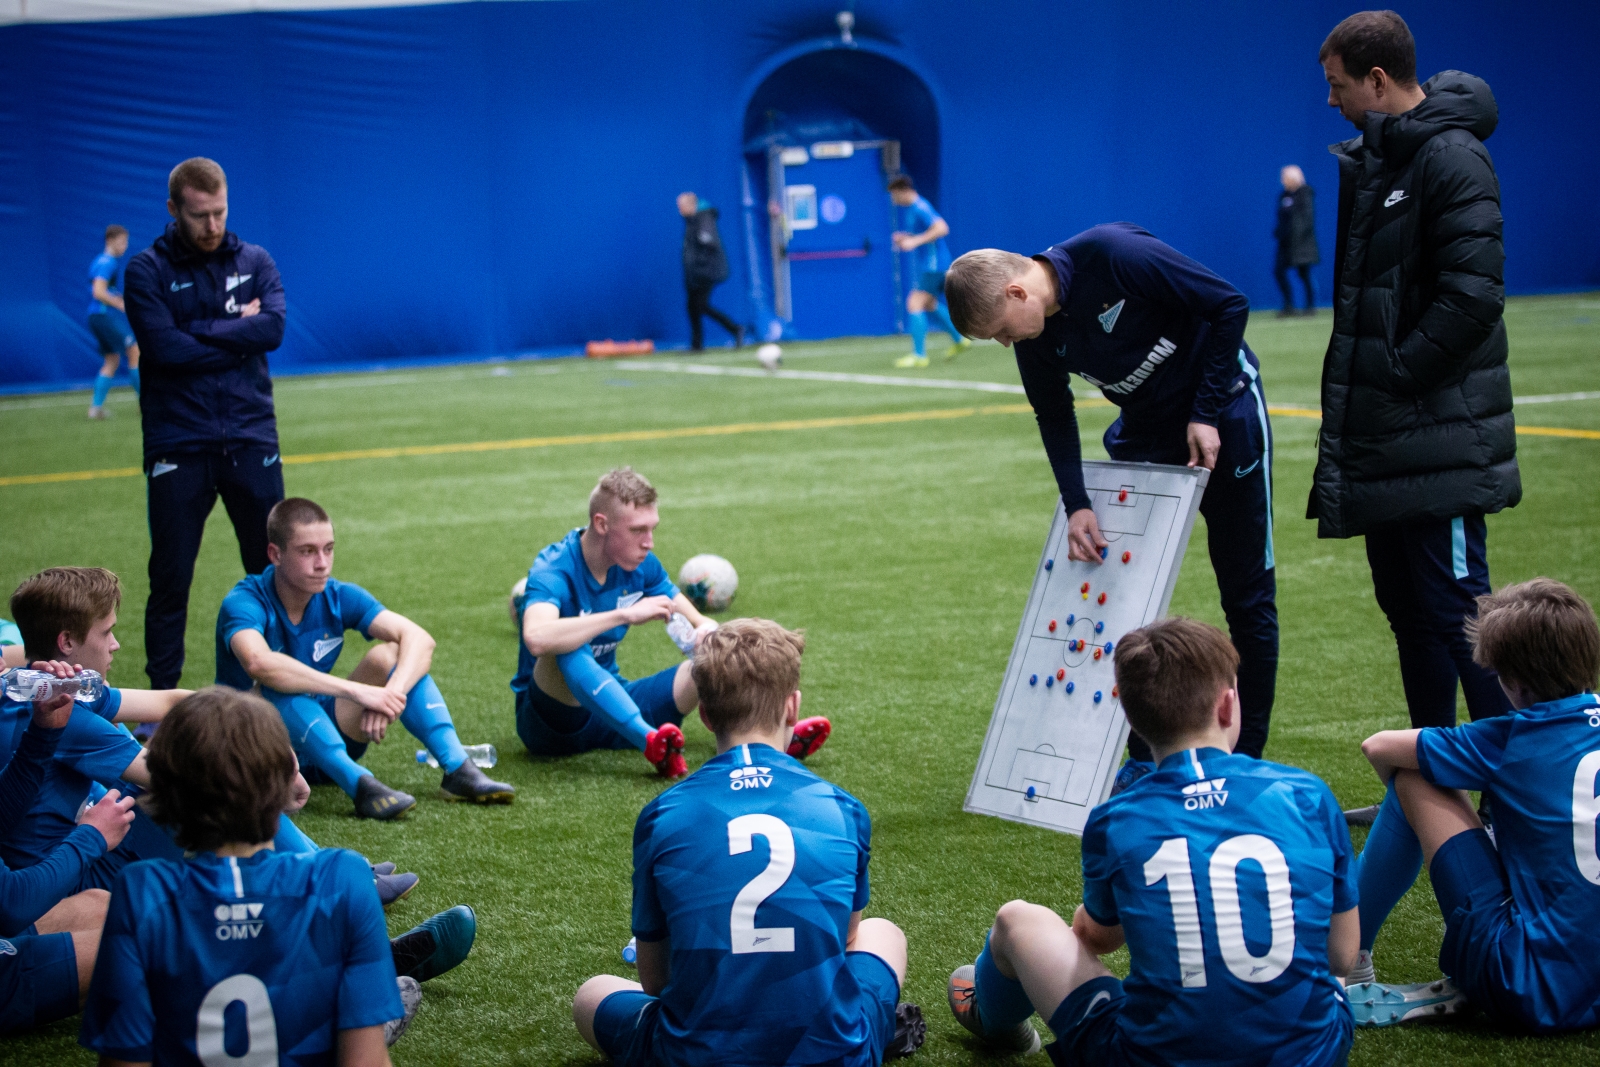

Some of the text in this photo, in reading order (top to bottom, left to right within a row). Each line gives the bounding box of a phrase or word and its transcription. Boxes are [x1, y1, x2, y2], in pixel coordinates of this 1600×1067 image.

[730, 776, 773, 791] OMV
[1184, 792, 1229, 811] OMV
[727, 813, 796, 955] 2
[1143, 834, 1296, 988] 10
[215, 924, 264, 941] OMV
